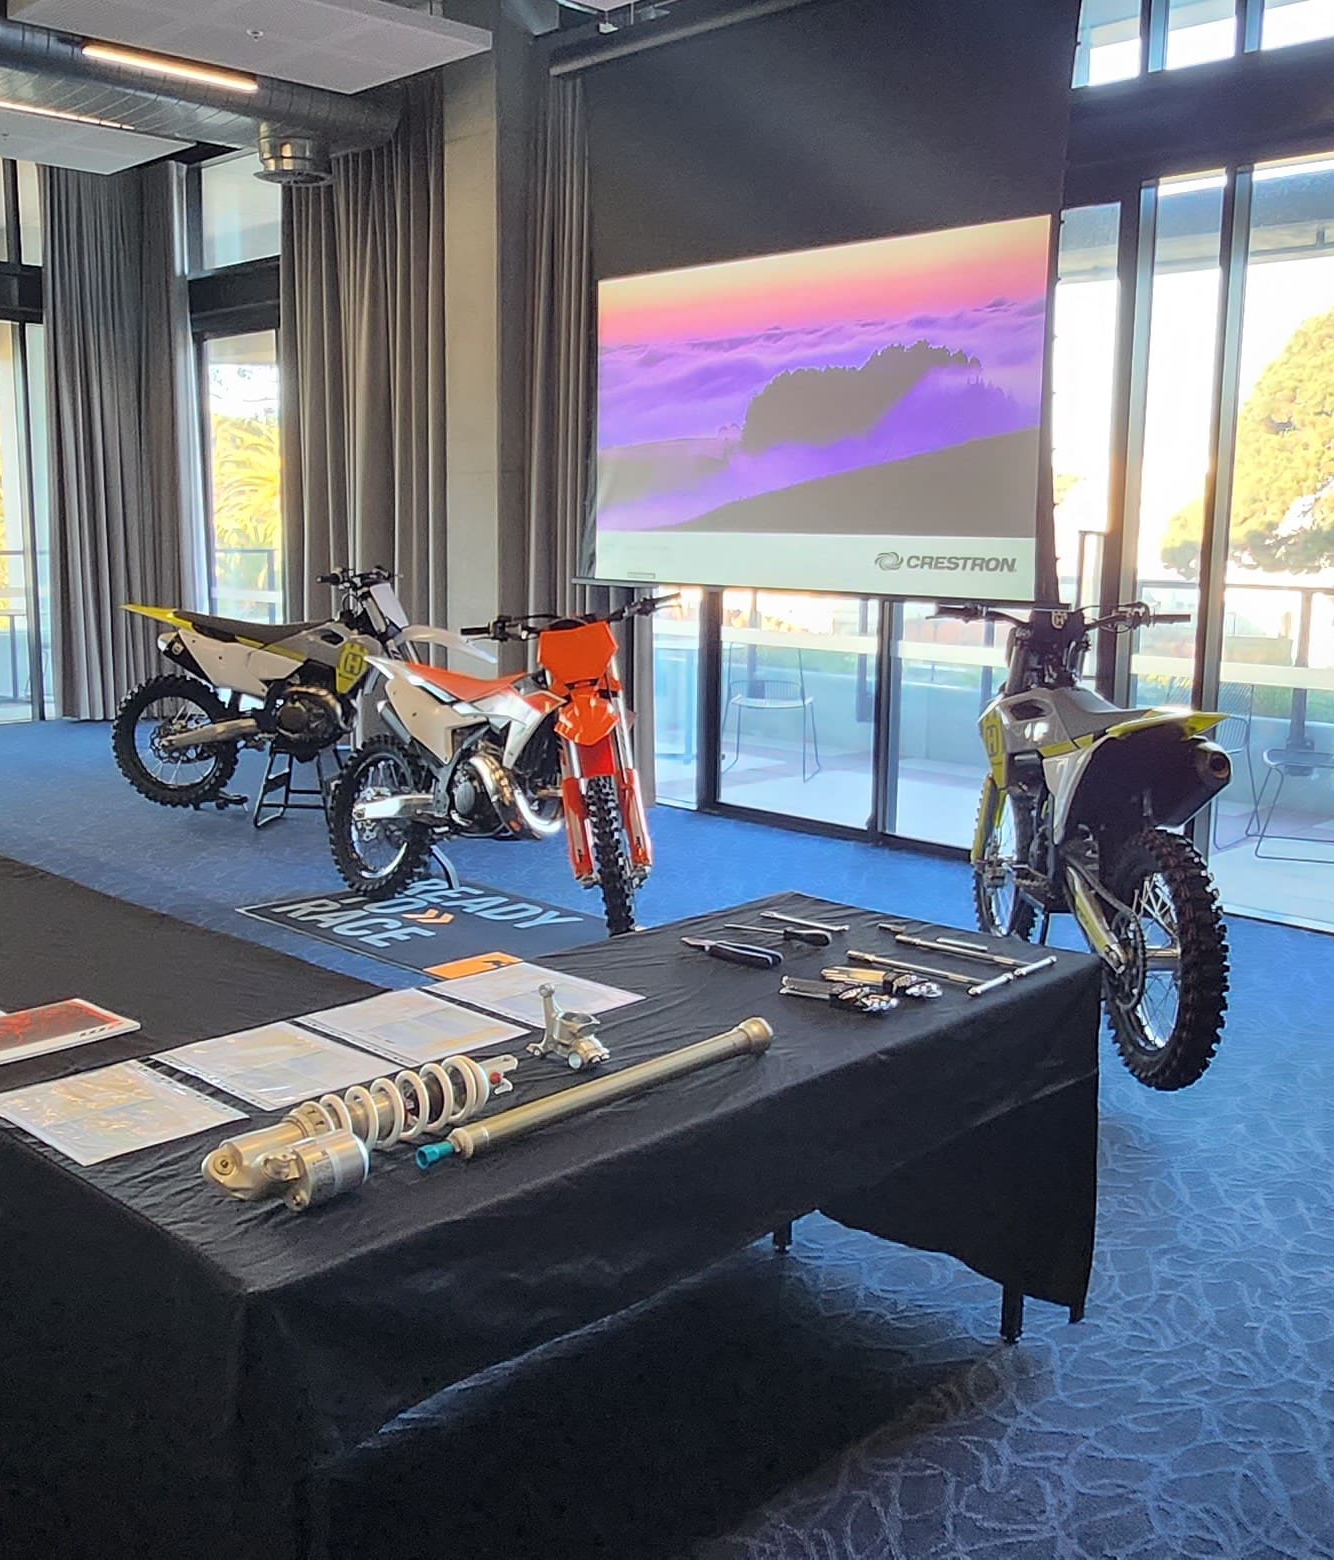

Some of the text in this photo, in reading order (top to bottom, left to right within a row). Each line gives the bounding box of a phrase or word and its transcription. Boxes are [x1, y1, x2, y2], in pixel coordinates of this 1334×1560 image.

[907, 555, 1017, 573] CRESTRON
[271, 899, 436, 947] RACE
[404, 878, 583, 928] READY
